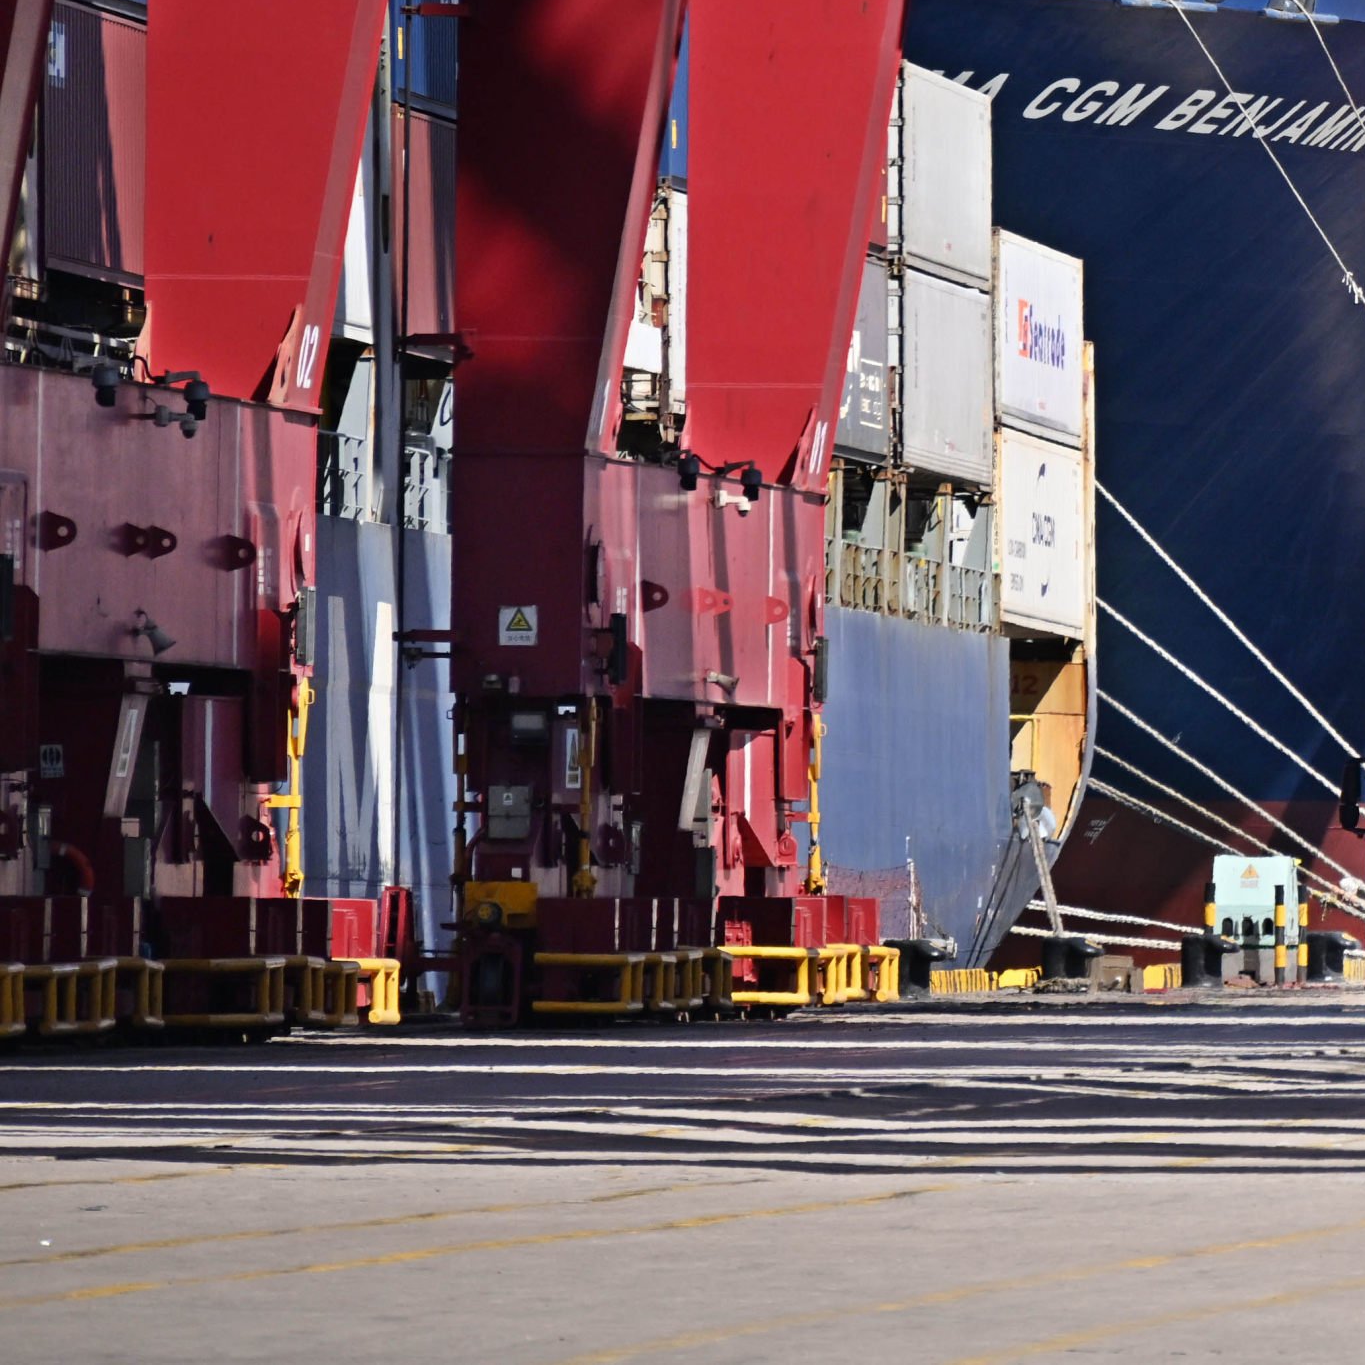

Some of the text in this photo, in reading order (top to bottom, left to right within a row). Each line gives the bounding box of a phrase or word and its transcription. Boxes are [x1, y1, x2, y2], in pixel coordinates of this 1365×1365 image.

[1022, 77, 1170, 127] CGM
[296, 325, 320, 389] 02
[1028, 303, 1066, 371] Seatrade
